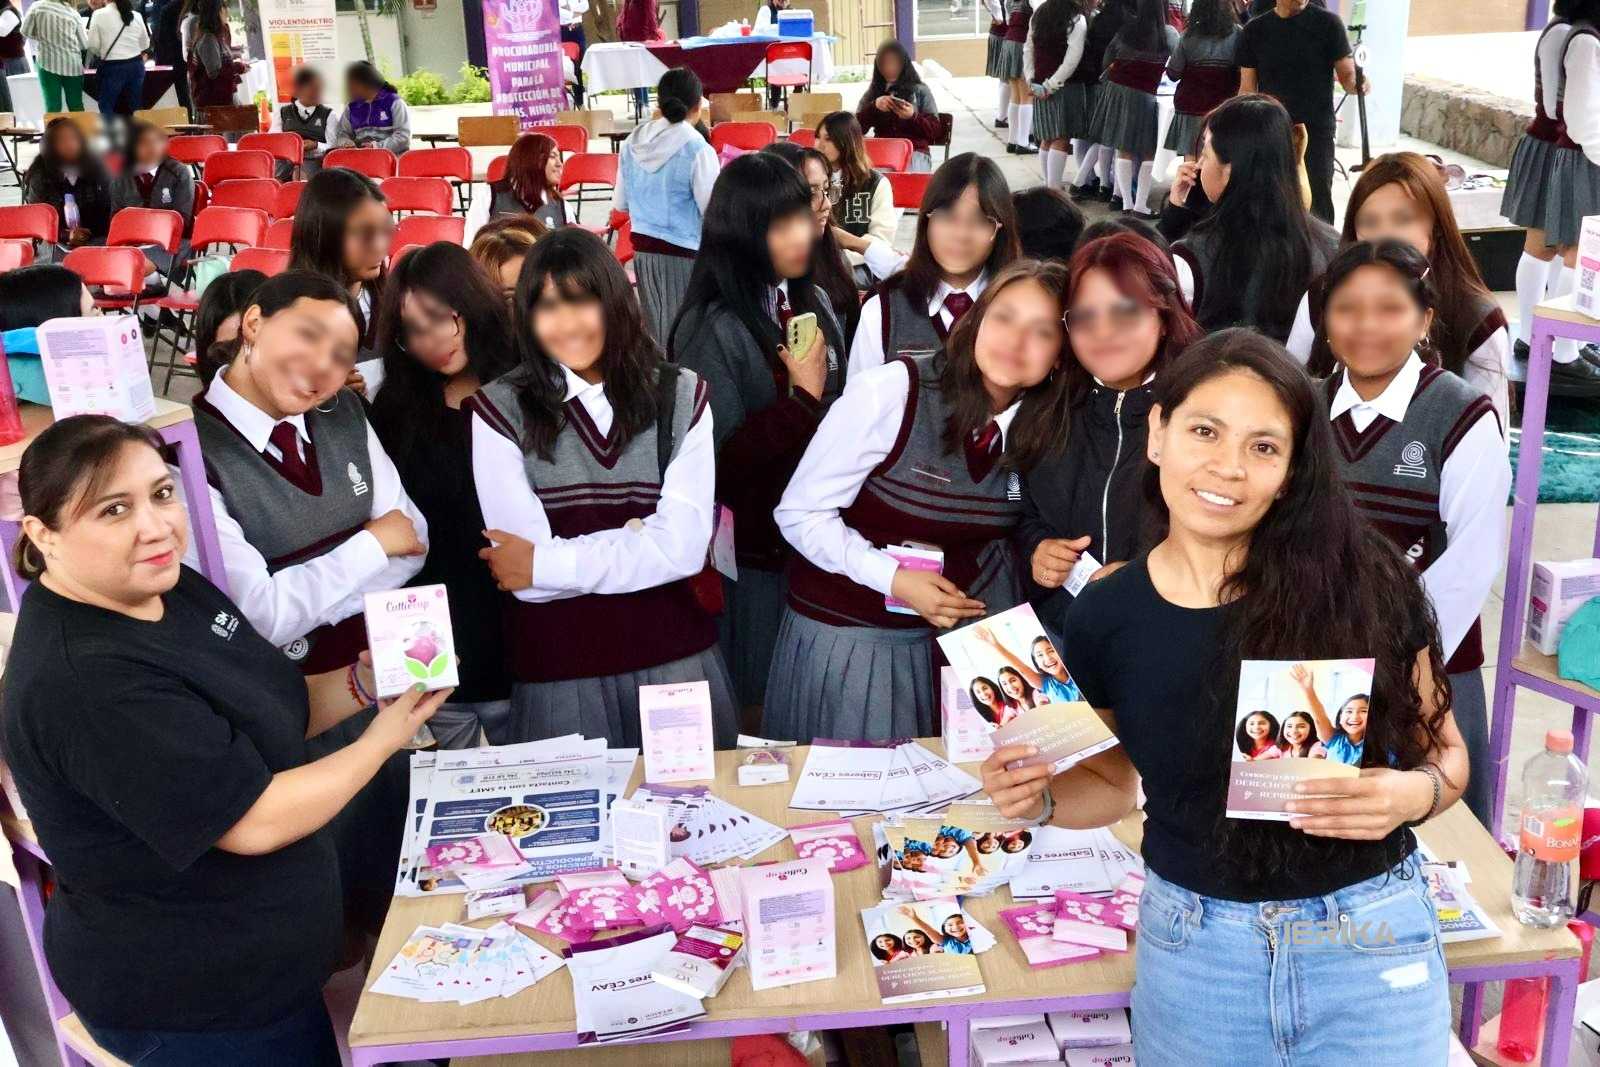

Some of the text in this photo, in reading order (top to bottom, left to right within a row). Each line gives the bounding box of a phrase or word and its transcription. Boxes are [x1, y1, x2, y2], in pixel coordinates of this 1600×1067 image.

[504, 58, 551, 72] MUNICIPAL
[511, 73, 544, 87] PARA LA
[845, 192, 872, 224] H
[837, 771, 879, 780] Saberes
[1044, 850, 1090, 858] Saberes
